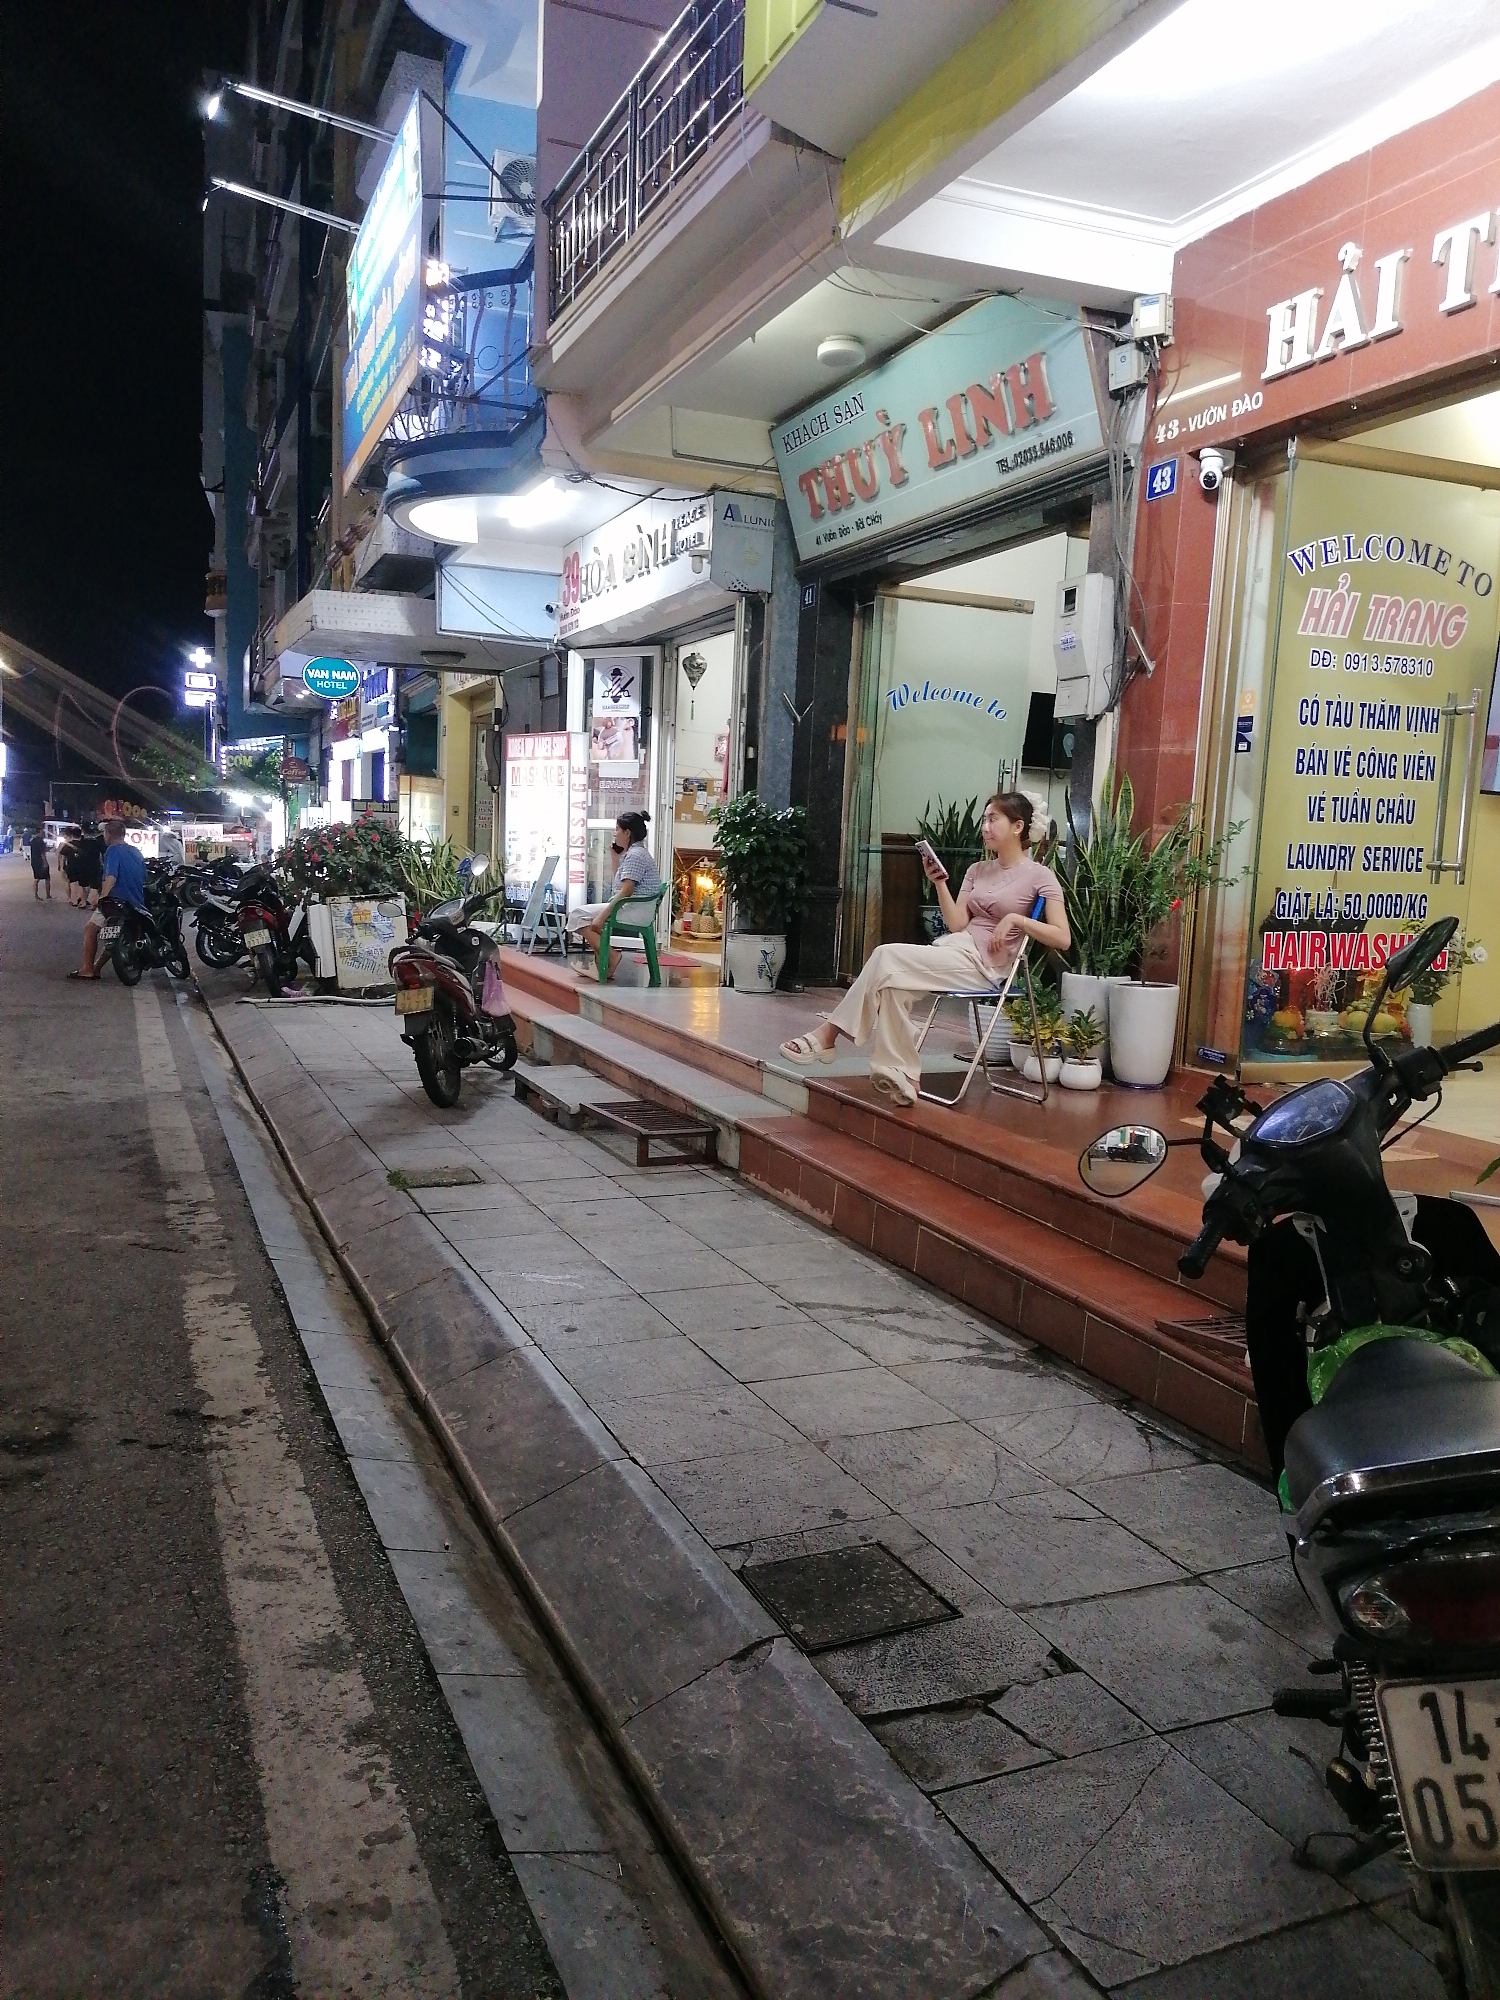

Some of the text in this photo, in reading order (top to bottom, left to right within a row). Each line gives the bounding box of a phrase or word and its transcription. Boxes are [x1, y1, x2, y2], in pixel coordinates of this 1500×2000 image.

[1261, 241, 1413, 382] HẢI
[781, 392, 866, 452] KHÁCH SẠN
[918, 352, 1058, 471] LINH
[1154, 419, 1179, 444] 43
[1188, 404, 1227, 432] VƯỜN
[1231, 391, 1263, 418] ĐÀO
[1152, 466, 1171, 494] 43
[1287, 534, 1493, 597] WELCOME TO
[804, 588, 813, 605] 41
[1297, 573, 1469, 650] HẢI TRANG
[307, 668, 357, 681] VAN NAM
[1309, 648, 1434, 677] DĐ: 0913.578310
[316, 680, 348, 690] HOTEL
[886, 680, 1008, 721] Welcome to
[1299, 693, 1441, 738] CÓ TÀU THĂM VỊNH
[1295, 743, 1437, 782] BÁN VÉ CÔNG VIÊN
[569, 766, 587, 884] MASSAGE
[1308, 786, 1416, 825] VÉ TUẦN CHÂU
[1286, 843, 1425, 873] LAUNDRY SERVICE
[1275, 886, 1428, 924] GIẶT LÀ: 50.000Đ/KG
[1262, 931, 1327, 971] HAIR
